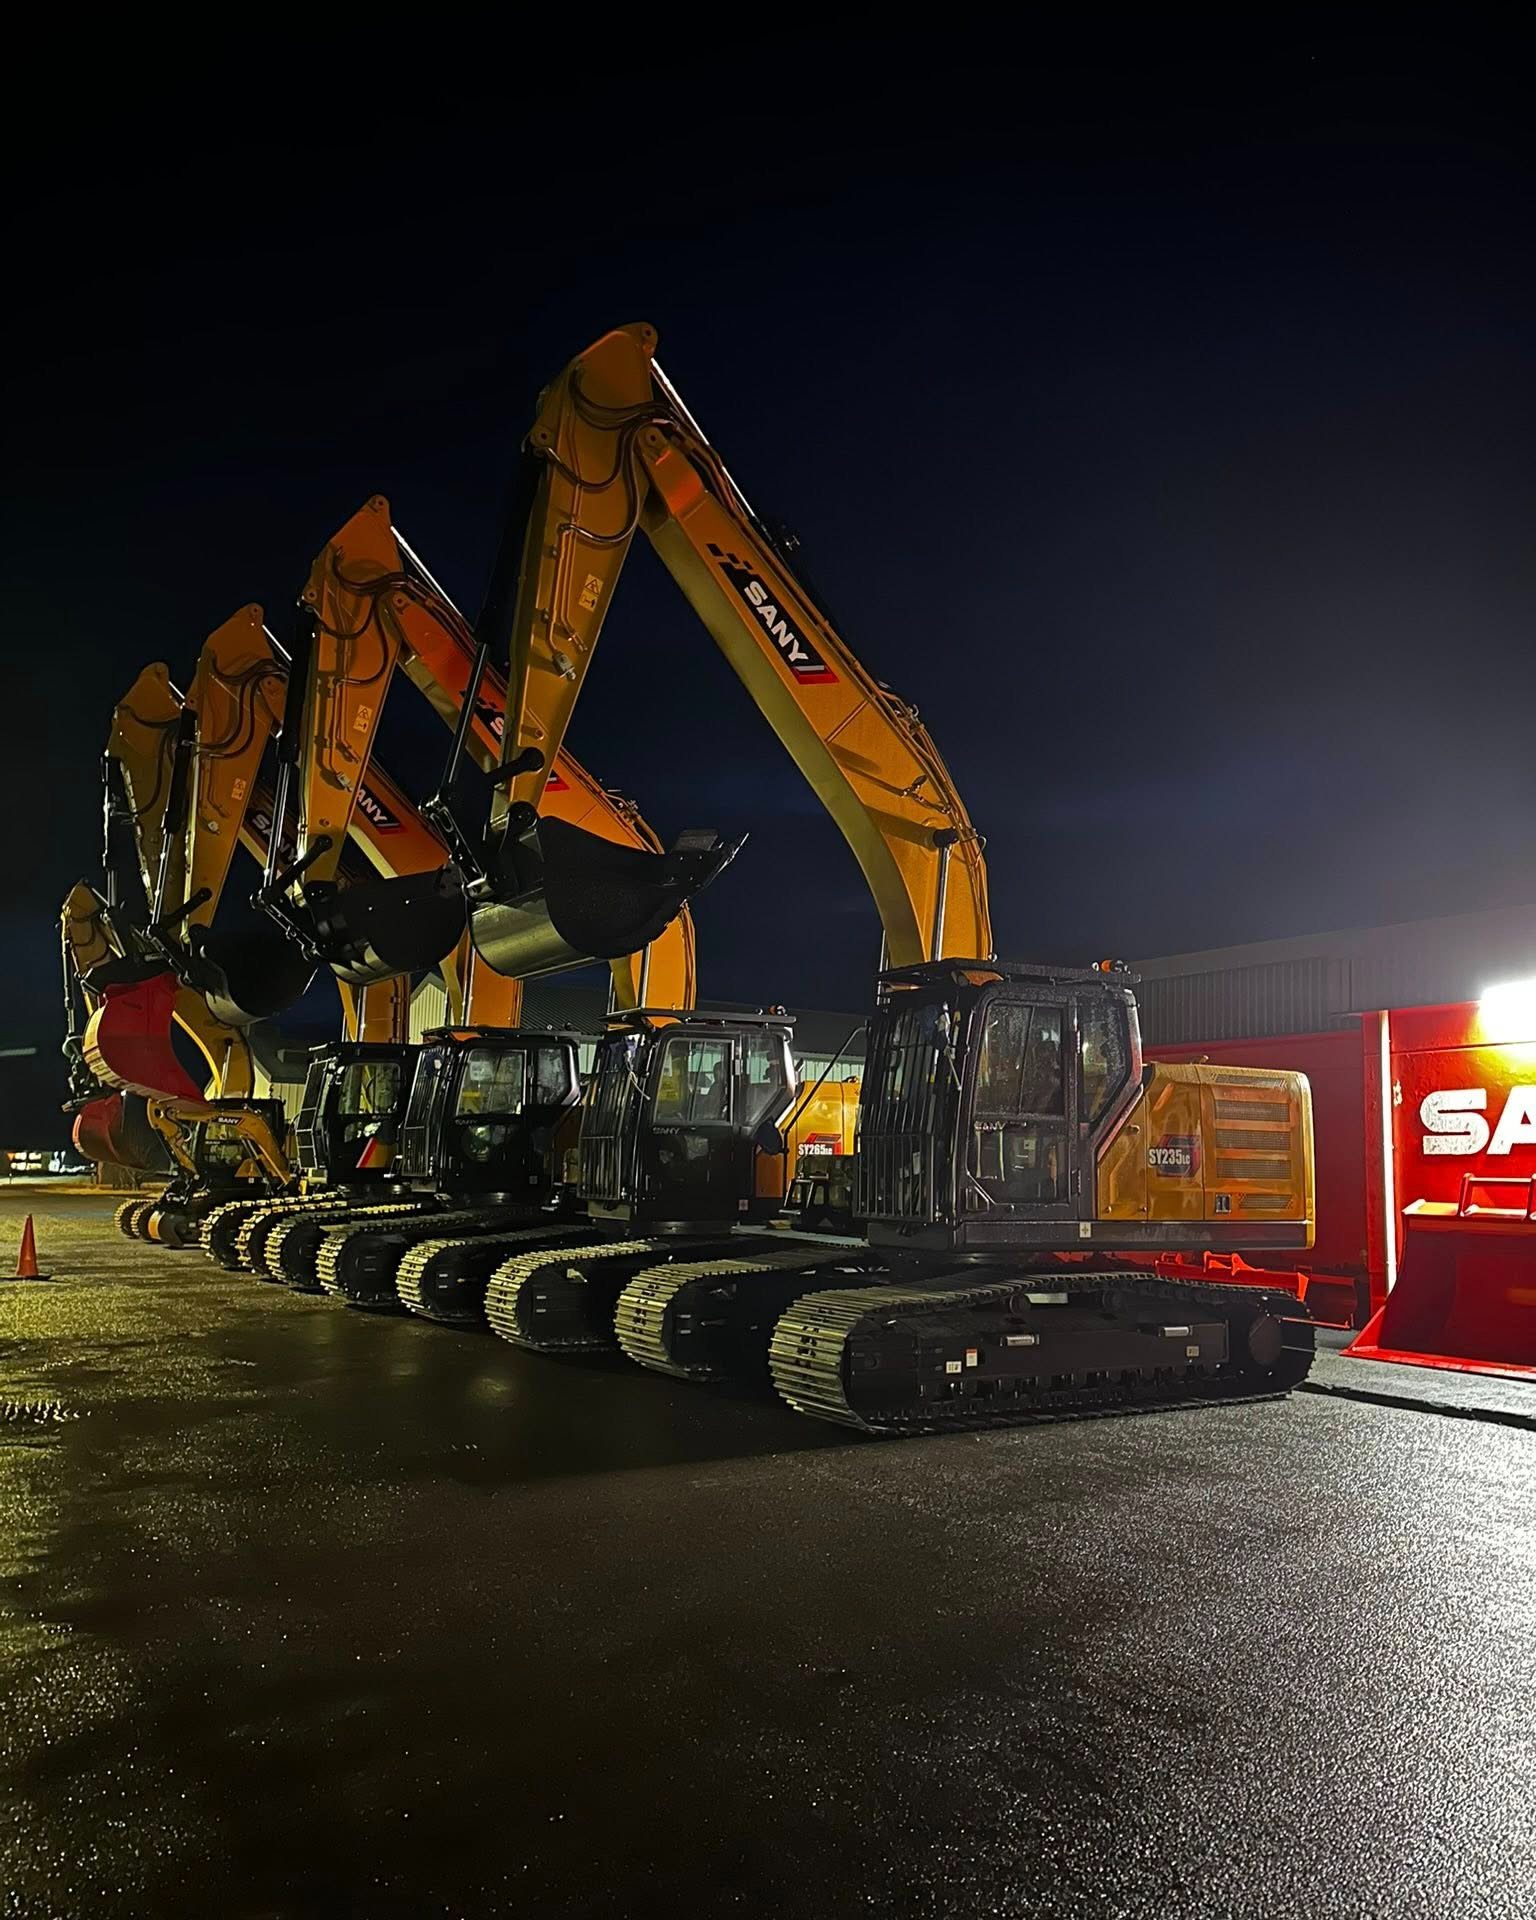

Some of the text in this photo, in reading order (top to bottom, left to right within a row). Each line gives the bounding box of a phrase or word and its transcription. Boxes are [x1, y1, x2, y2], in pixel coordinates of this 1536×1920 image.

[743, 580, 809, 662] SANY
[357, 788, 388, 822] ANY
[1420, 1085, 1536, 1155] SA
[1148, 1148, 1191, 1165] SY235LC
